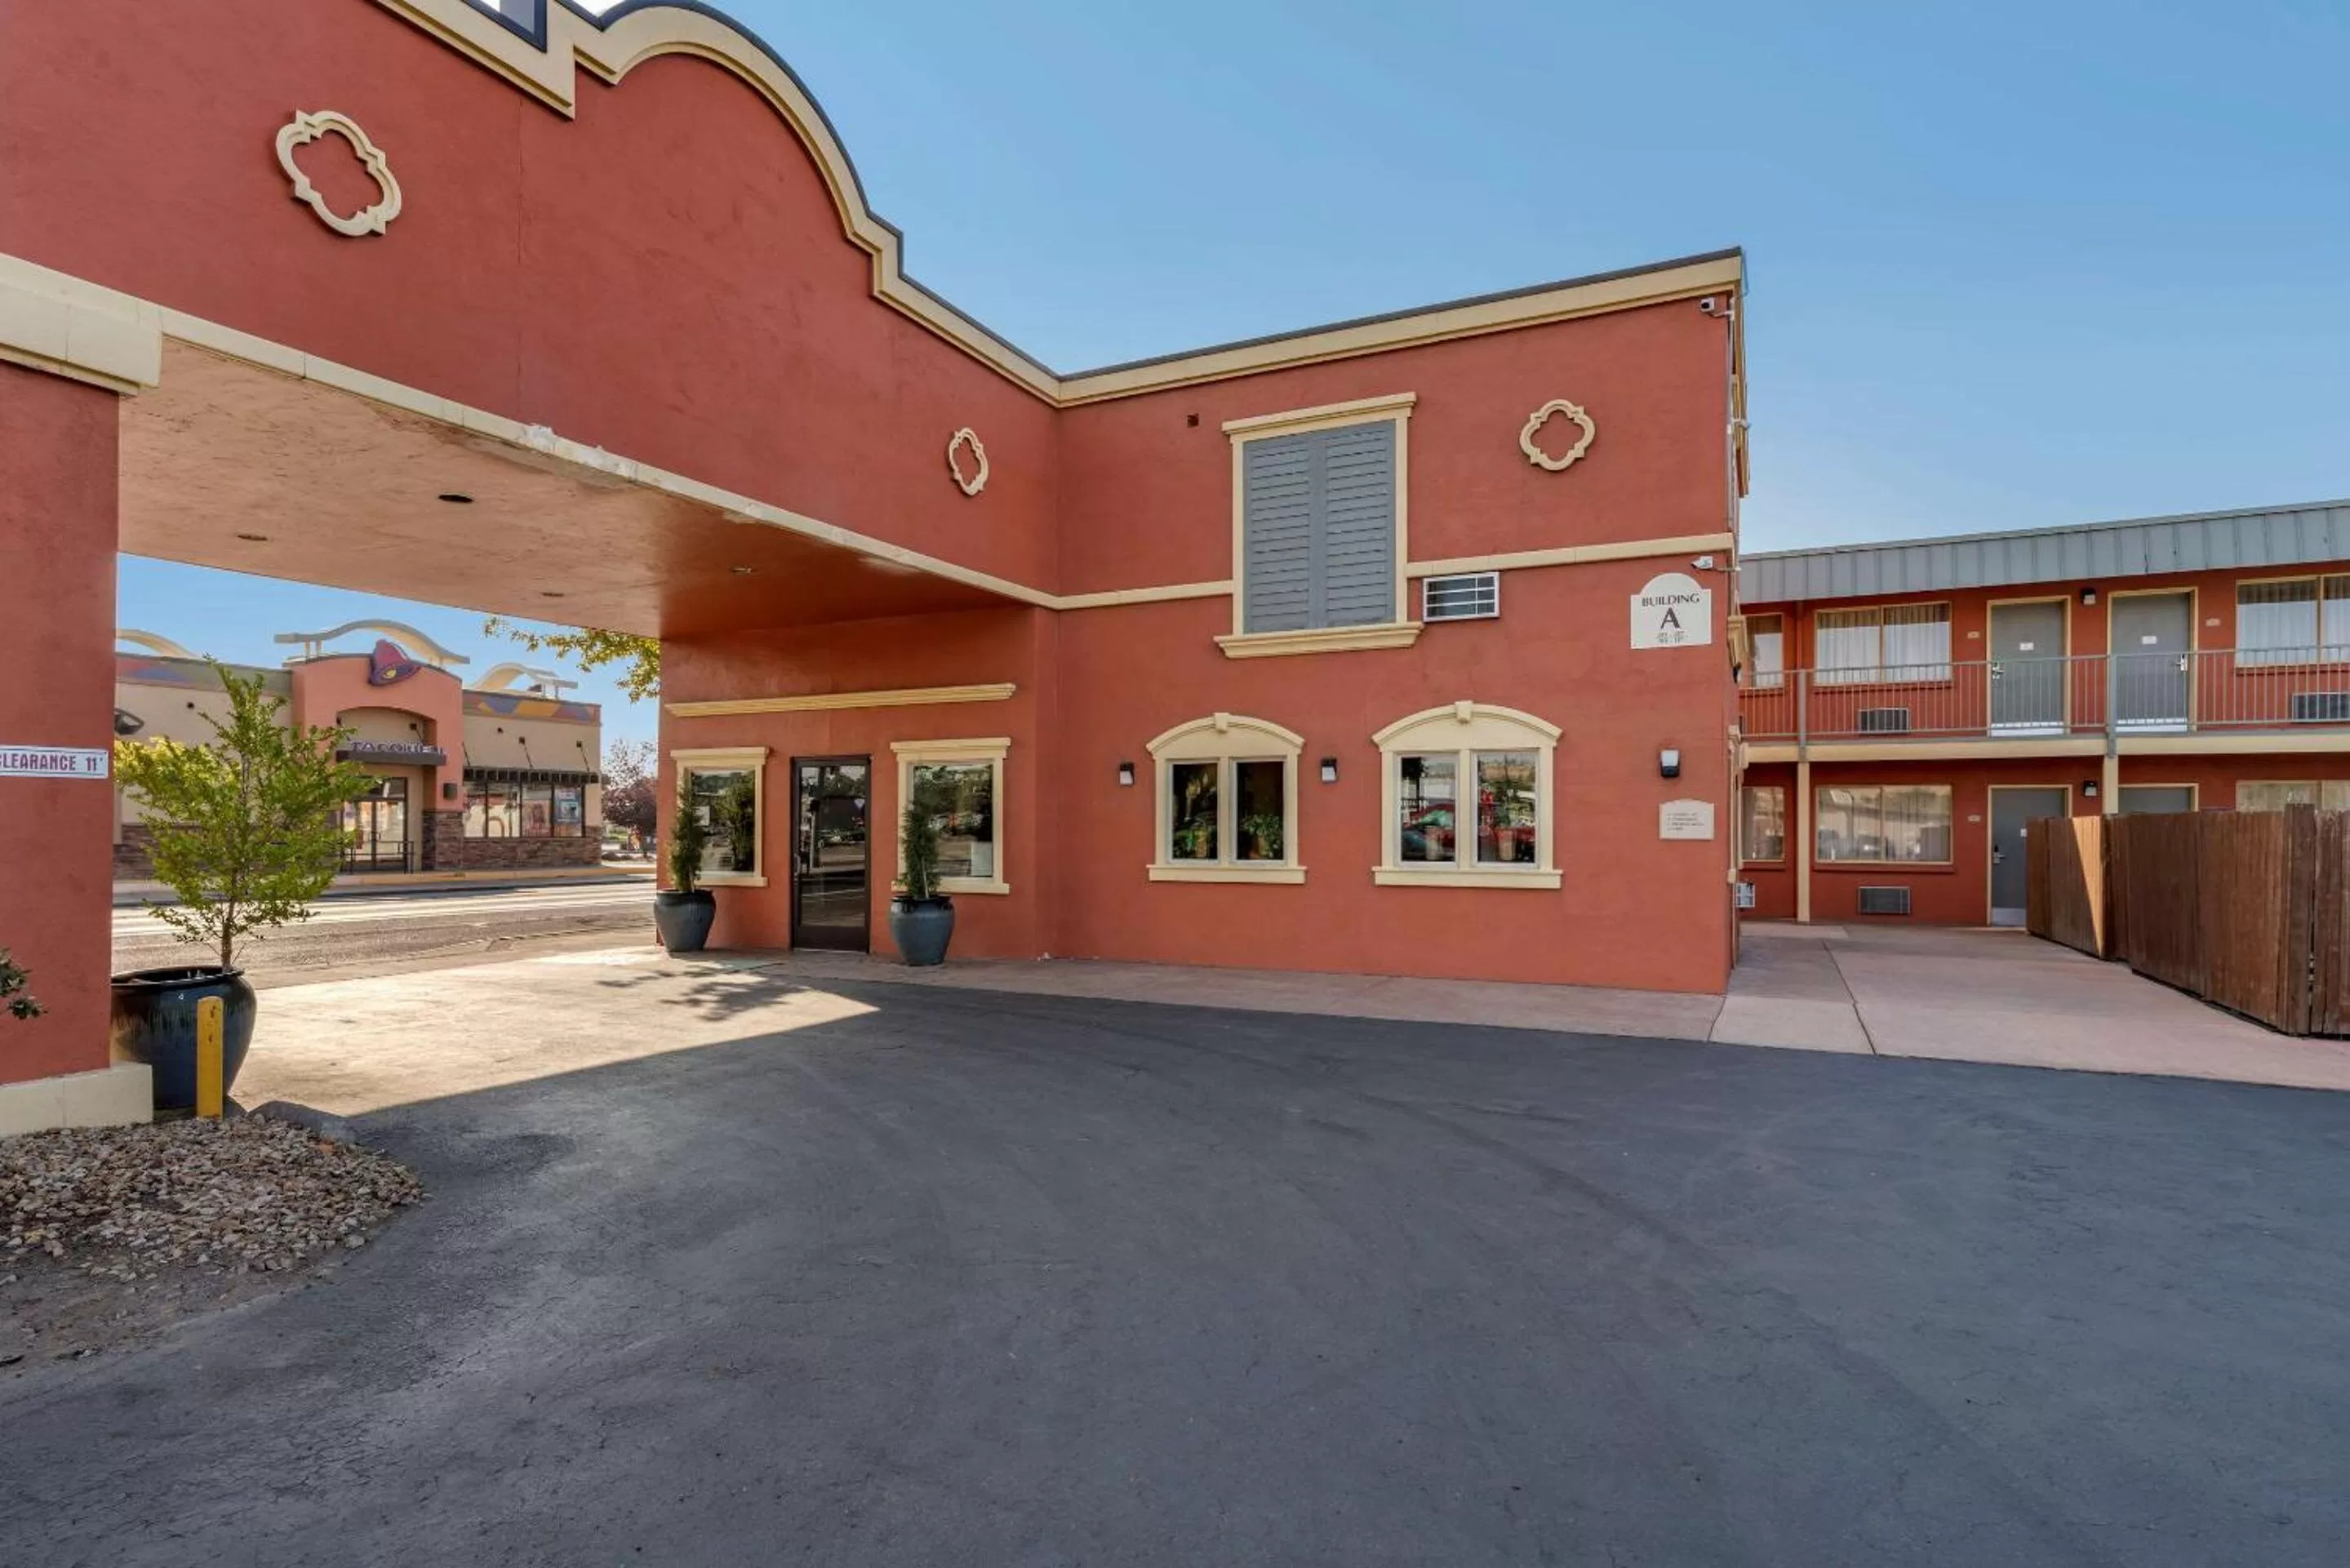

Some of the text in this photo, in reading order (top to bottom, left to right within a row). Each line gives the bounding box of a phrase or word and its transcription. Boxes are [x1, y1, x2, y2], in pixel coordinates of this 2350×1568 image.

[1641, 593, 1699, 606] BUILDING
[1660, 607, 1681, 629] A
[0, 753, 76, 771] LEARANCE
